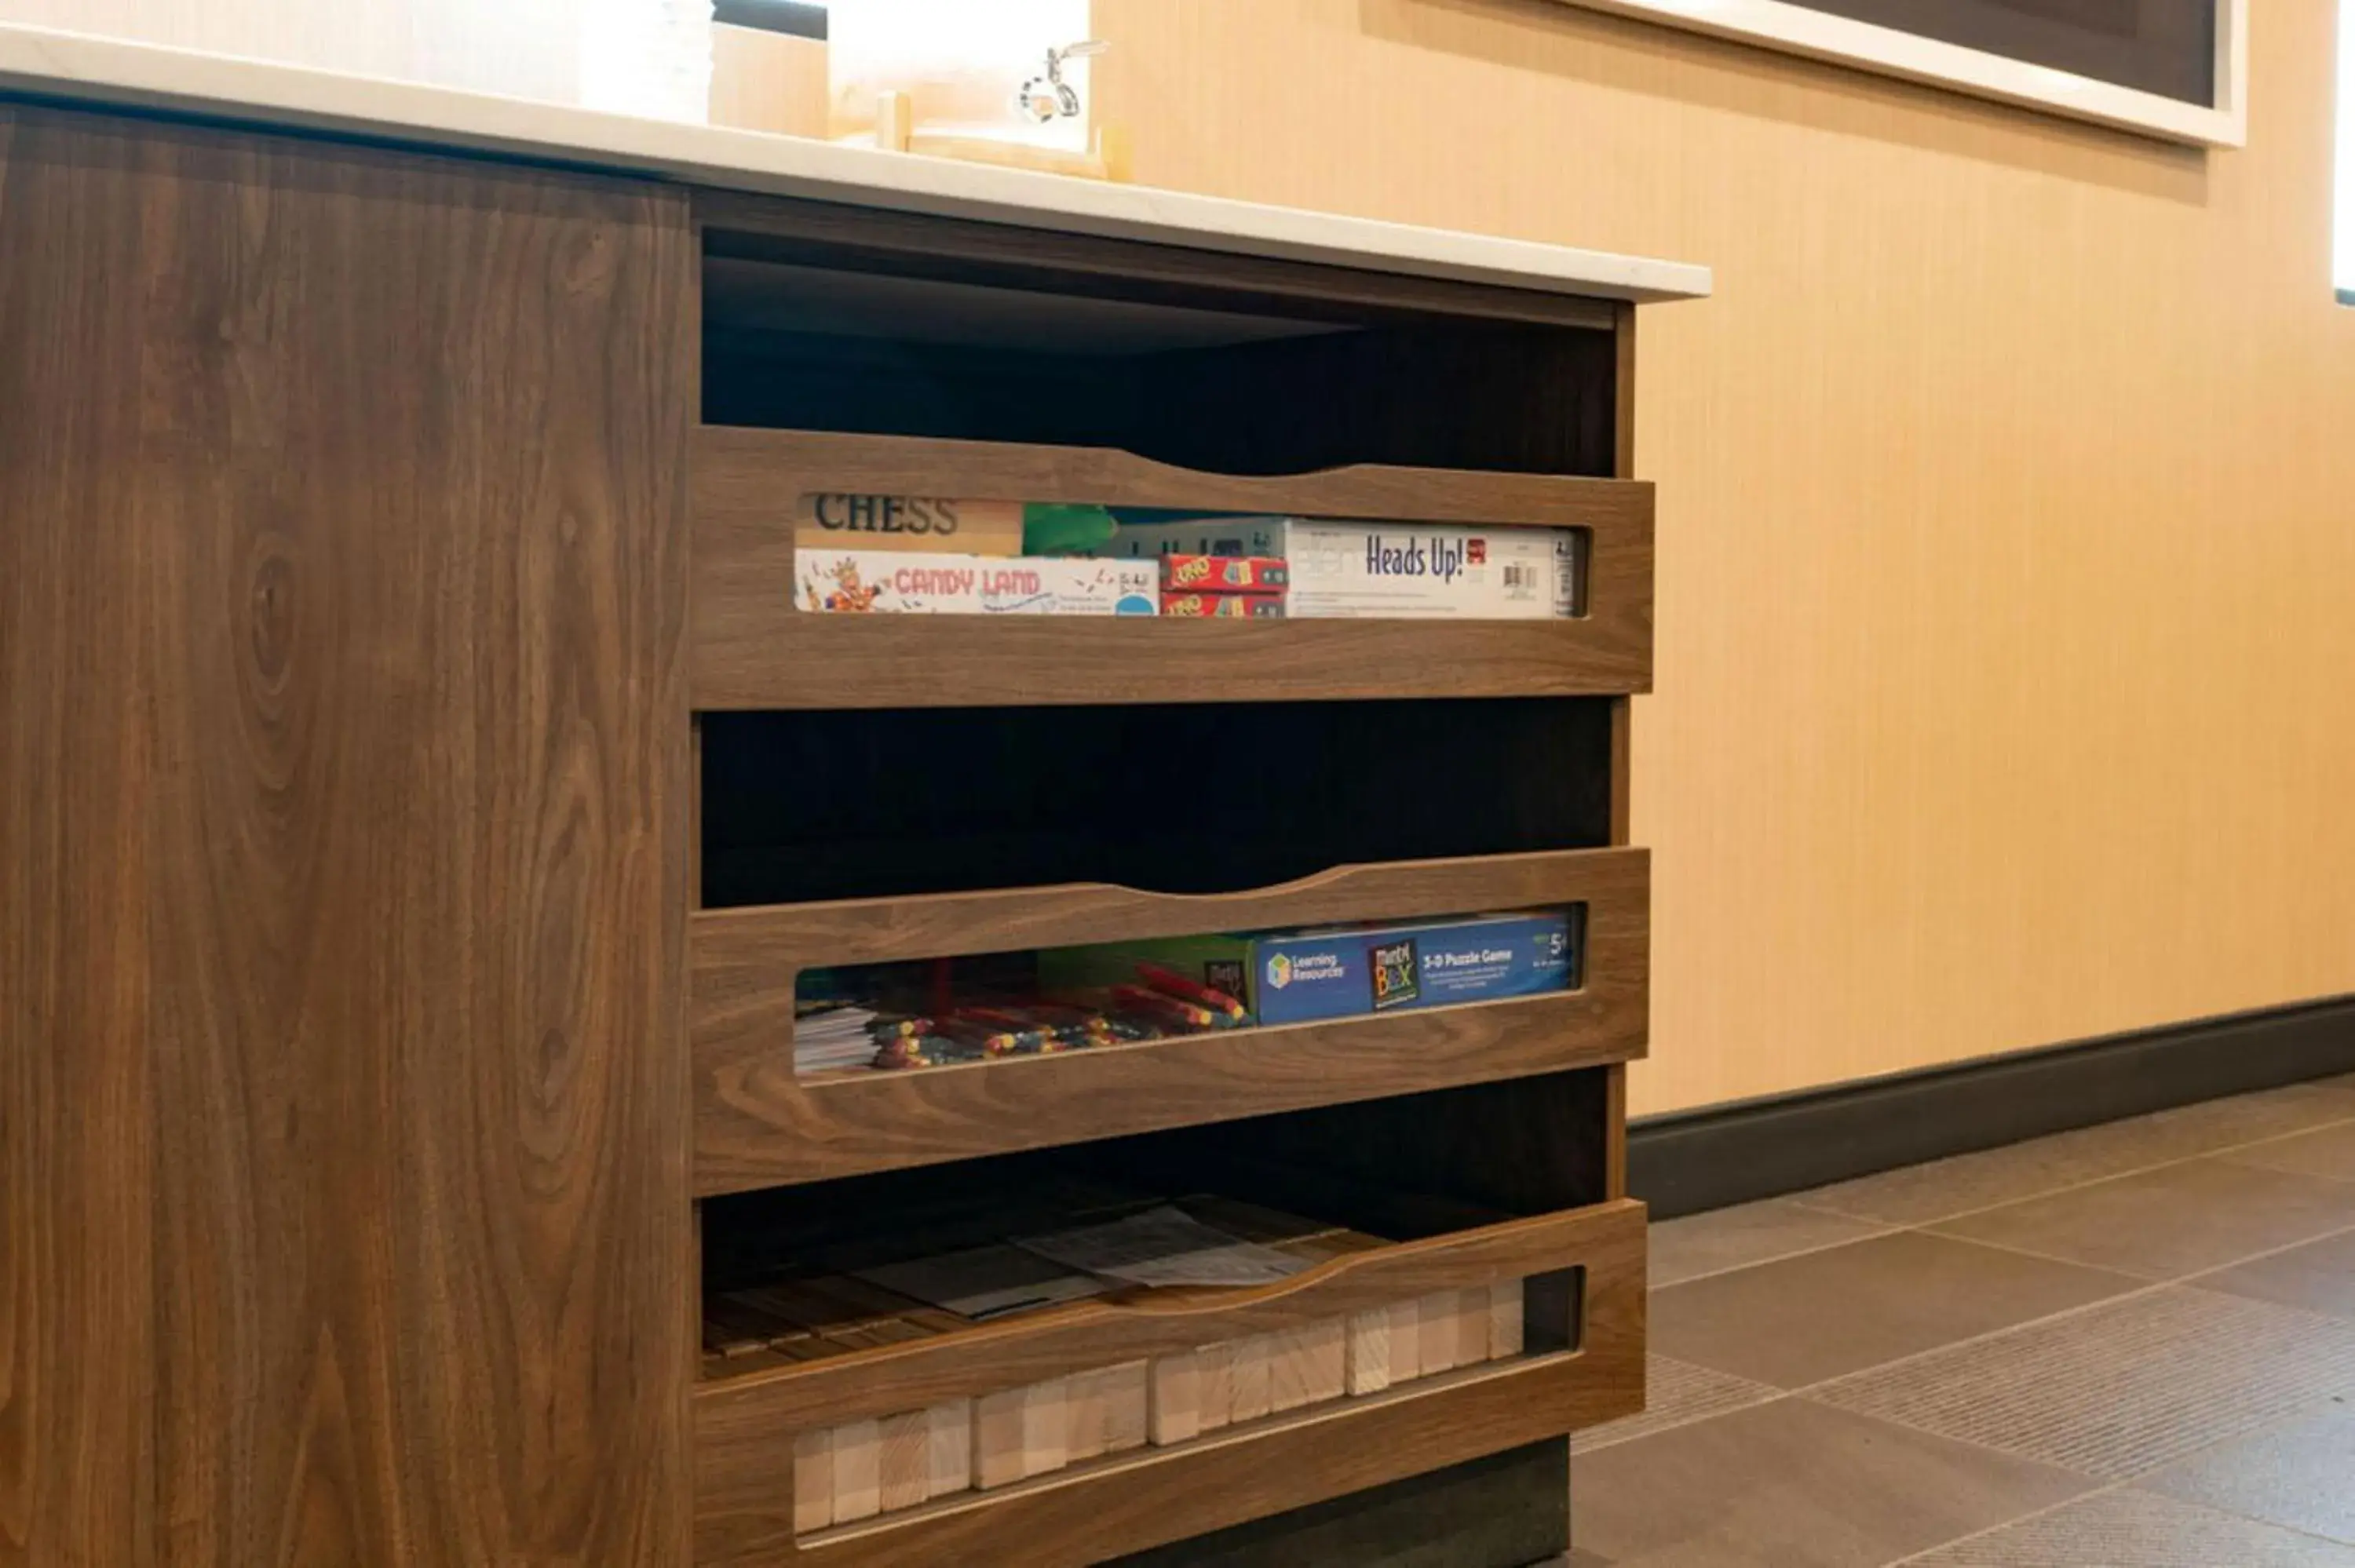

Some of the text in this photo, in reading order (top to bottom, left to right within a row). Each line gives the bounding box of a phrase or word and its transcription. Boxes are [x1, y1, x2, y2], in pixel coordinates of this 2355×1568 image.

[815, 493, 958, 535] CHESS
[1177, 557, 1210, 582] UNO
[1366, 534, 1425, 576] Heads
[1430, 537, 1463, 585] Up!
[895, 567, 1041, 596] CANDY LAND
[1292, 953, 1338, 968] Learning
